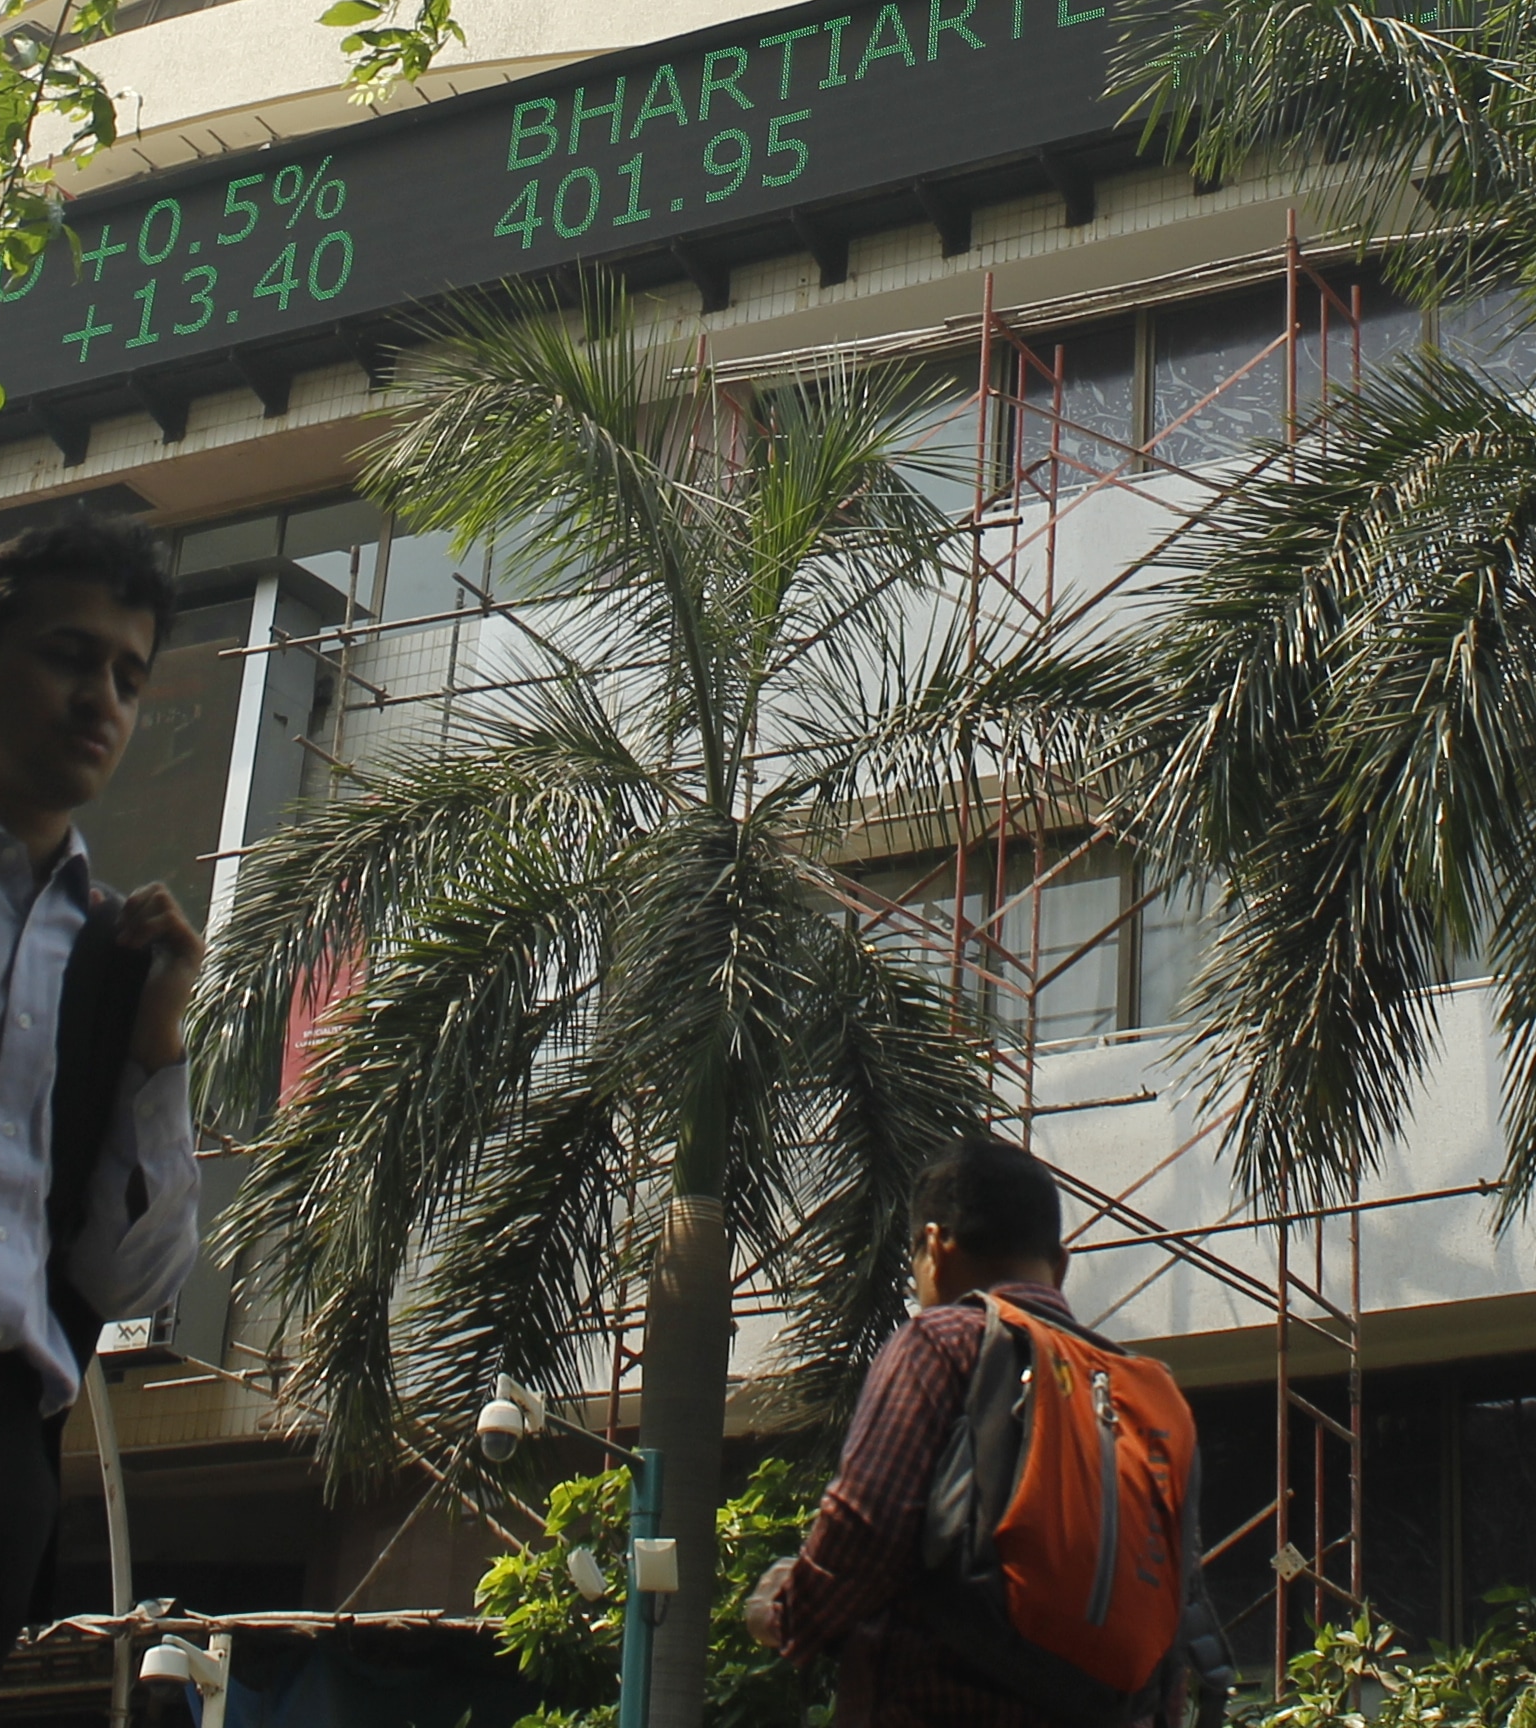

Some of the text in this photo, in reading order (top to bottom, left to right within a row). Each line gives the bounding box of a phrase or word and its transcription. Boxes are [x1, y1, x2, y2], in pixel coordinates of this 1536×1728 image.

[81, 155, 348, 282] +0.5%
[493, 108, 812, 250] 401.95
[62, 229, 356, 364] +13.40
